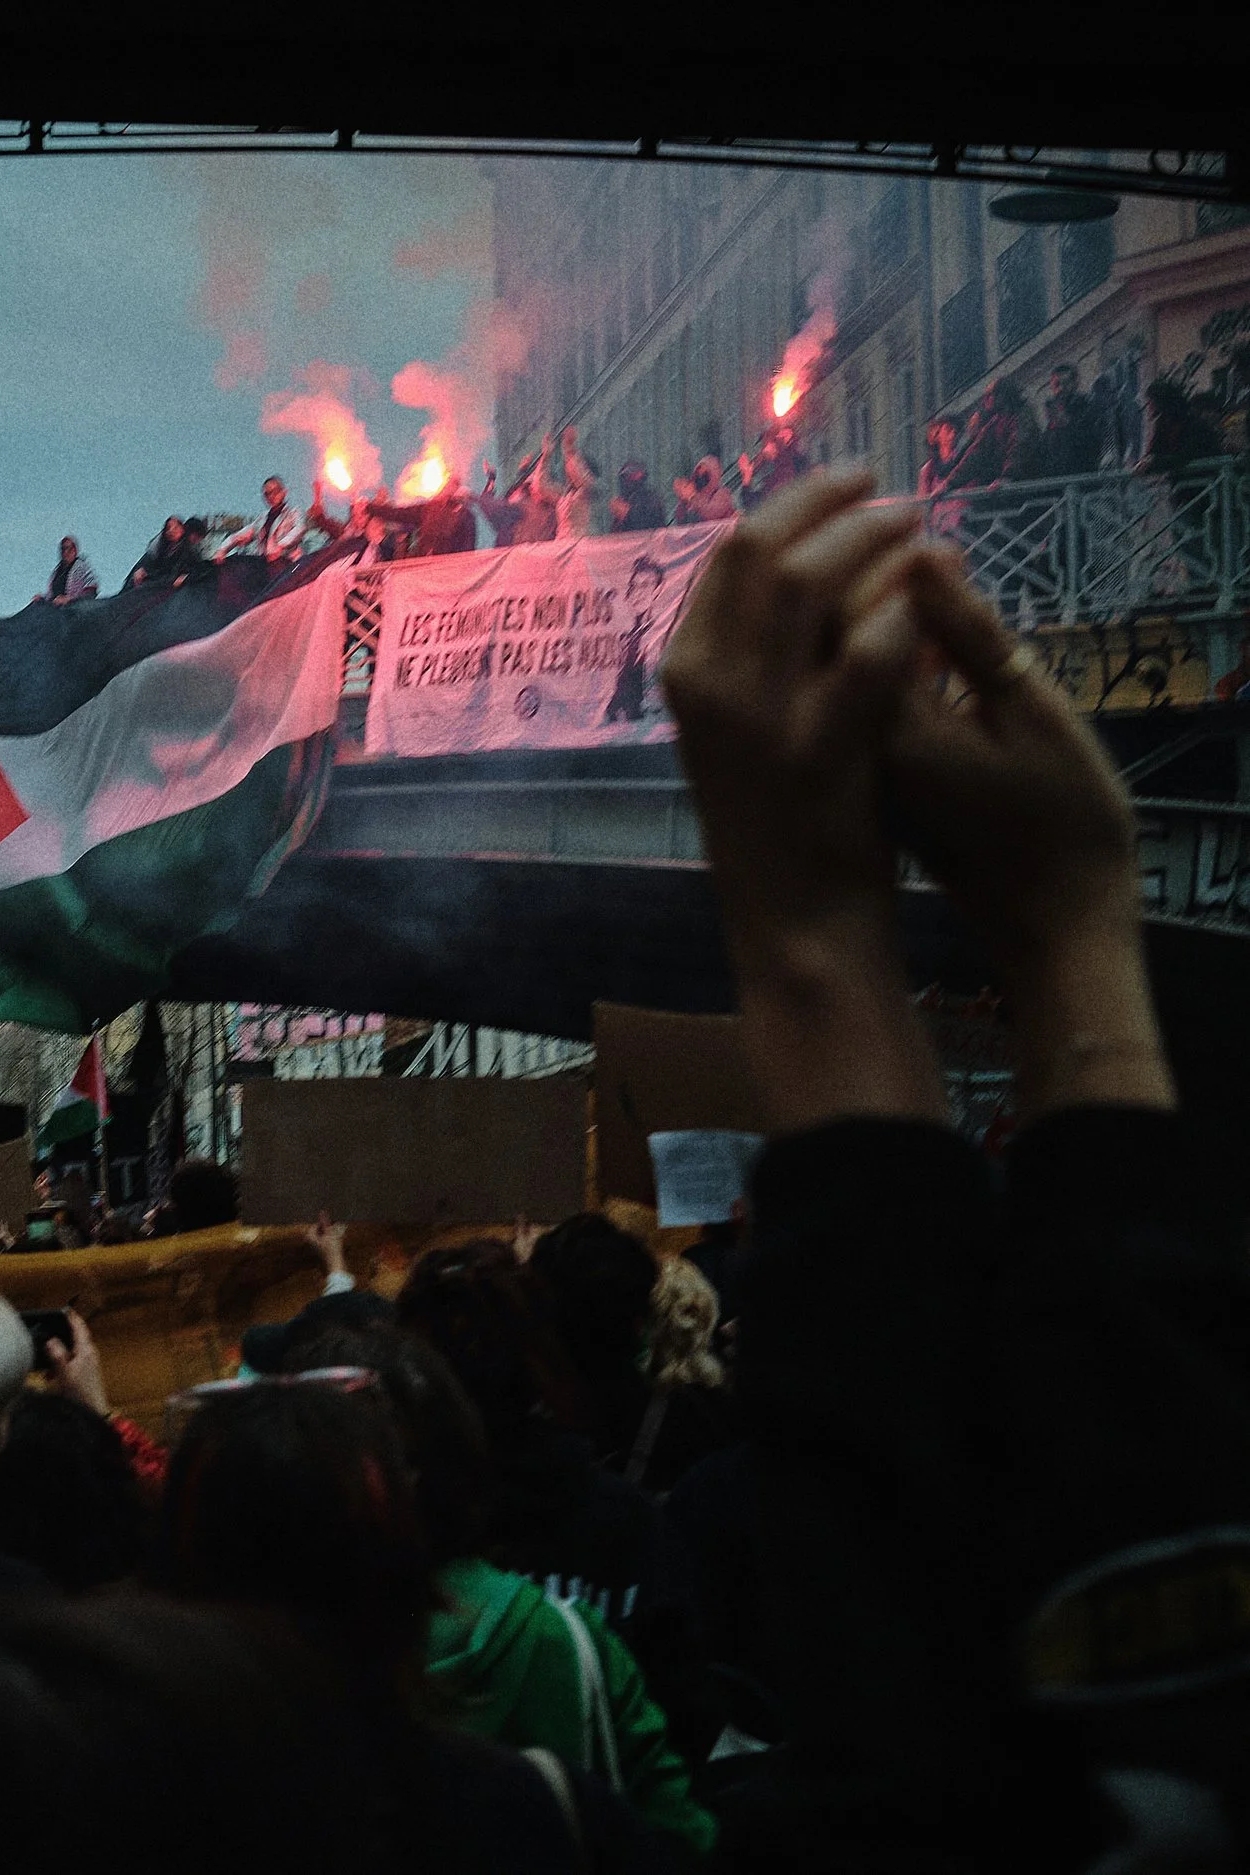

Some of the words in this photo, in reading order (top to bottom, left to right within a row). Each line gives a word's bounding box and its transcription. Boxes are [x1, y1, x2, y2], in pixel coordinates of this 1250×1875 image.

[399, 611, 434, 647] LES
[530, 594, 568, 631] NON
[570, 588, 617, 628] PLUS
[396, 654, 420, 688] NE
[498, 641, 537, 677] PAS
[538, 636, 573, 674] LES
